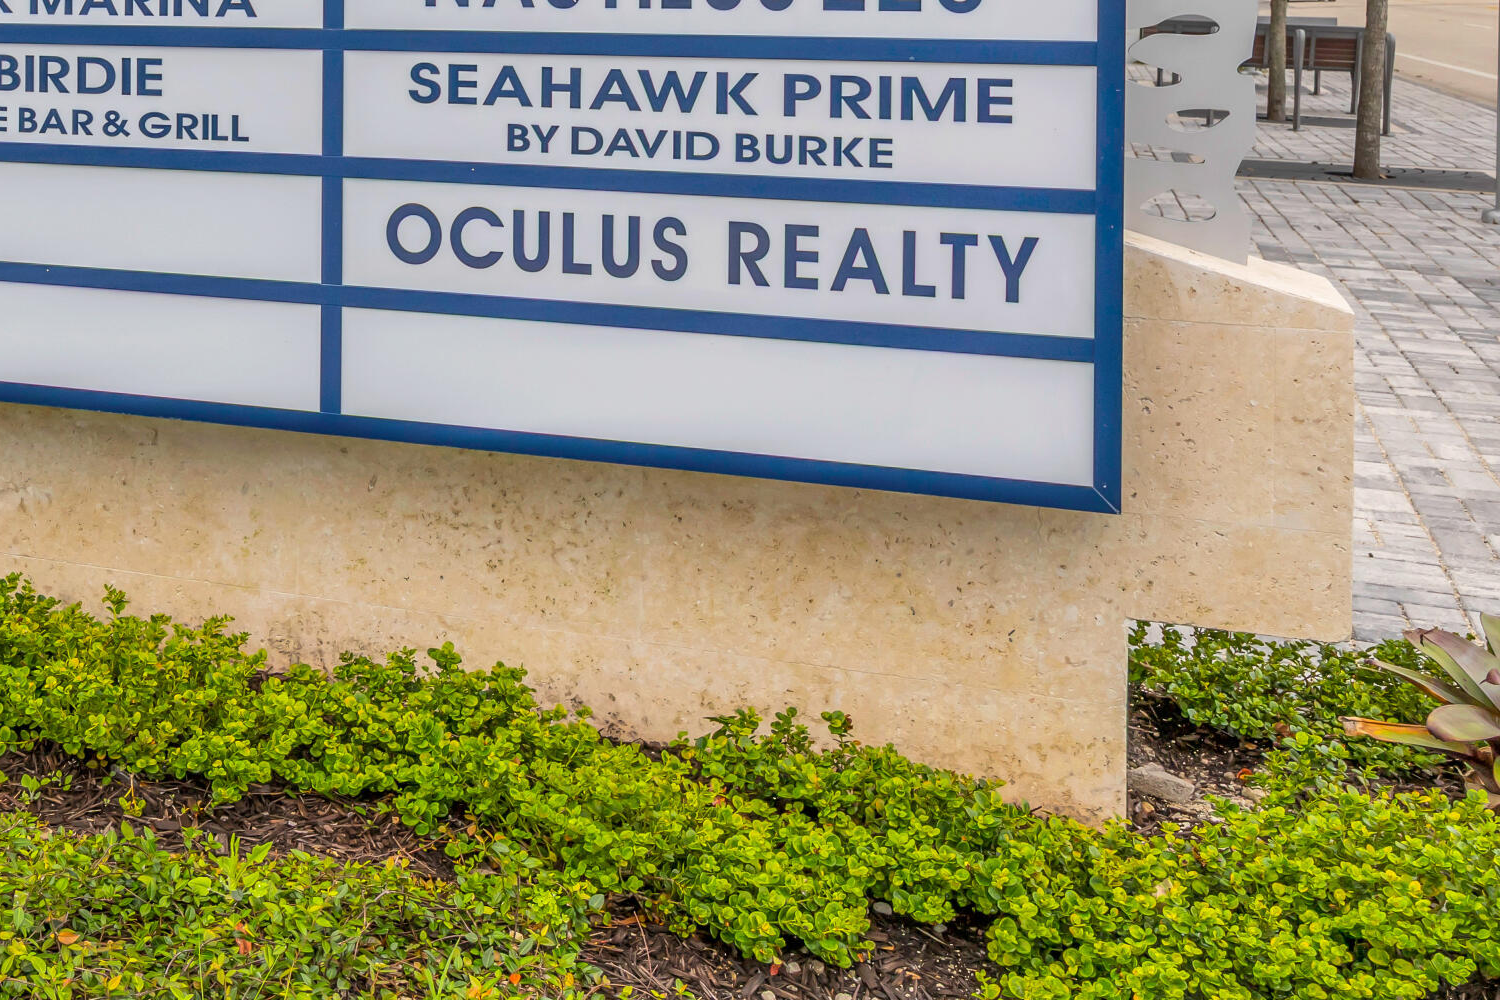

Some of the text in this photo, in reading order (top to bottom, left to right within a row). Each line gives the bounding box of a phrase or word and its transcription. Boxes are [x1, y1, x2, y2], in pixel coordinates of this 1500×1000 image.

[408, 62, 1013, 124] SEAHAWK PRIME
[18, 107, 94, 137] BAR
[101, 110, 131, 137] &
[138, 111, 250, 143] GRILL
[506, 123, 893, 169] BY DAVID BURKE
[385, 203, 1040, 304] OCULUS REALTY
